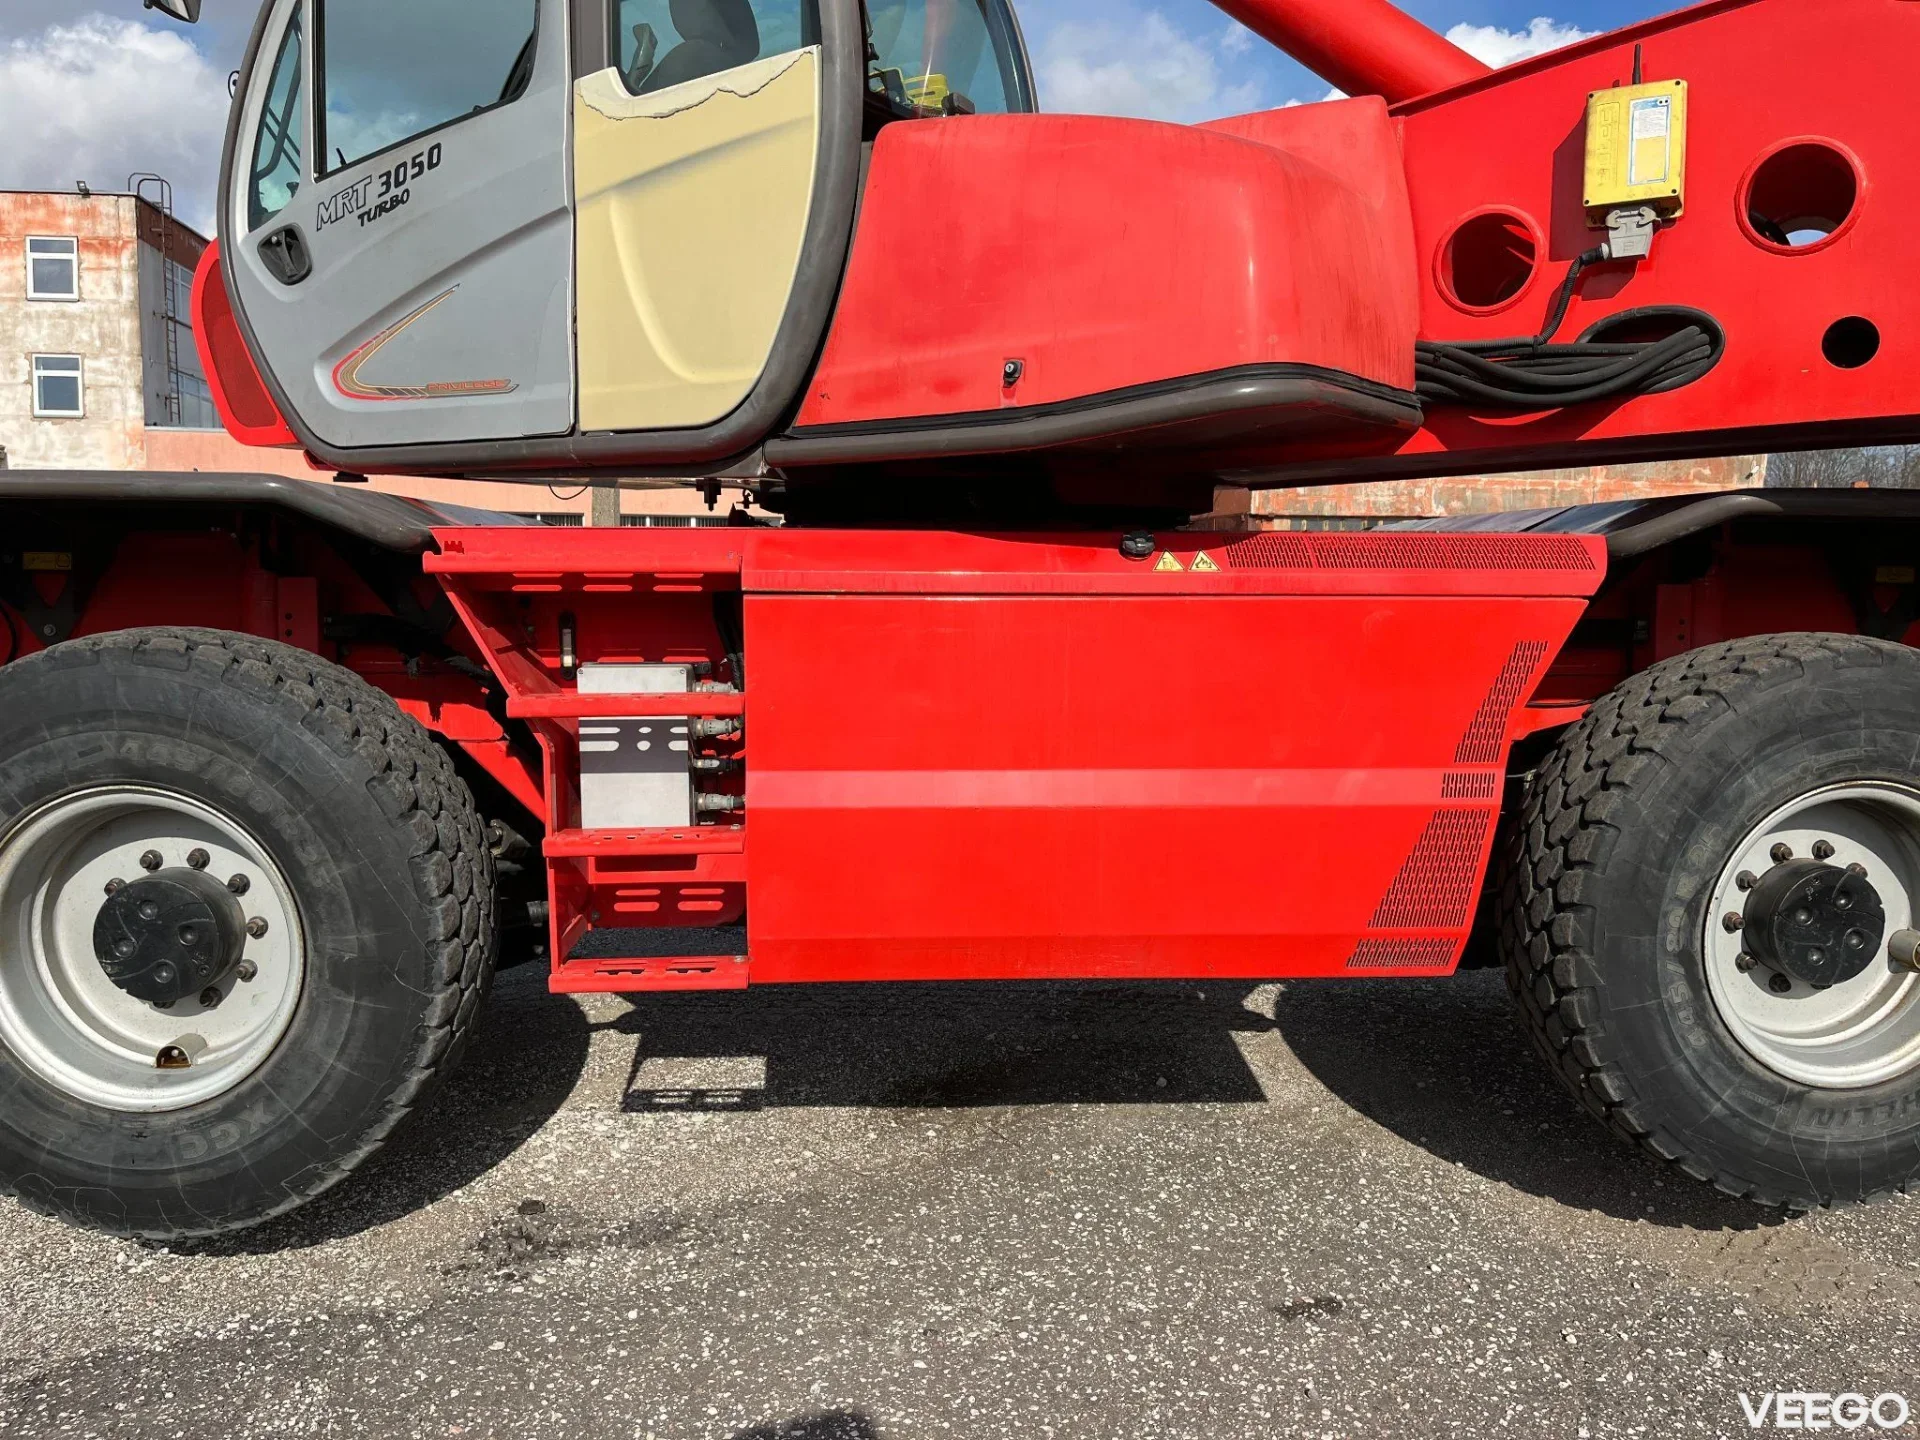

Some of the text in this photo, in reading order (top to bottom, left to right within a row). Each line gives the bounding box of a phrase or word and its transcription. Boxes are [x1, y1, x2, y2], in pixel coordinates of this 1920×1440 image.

[316, 142, 442, 232] MRT 3050
[357, 188, 410, 227] TURBO
[428, 380, 506, 391] PRIVILEGE
